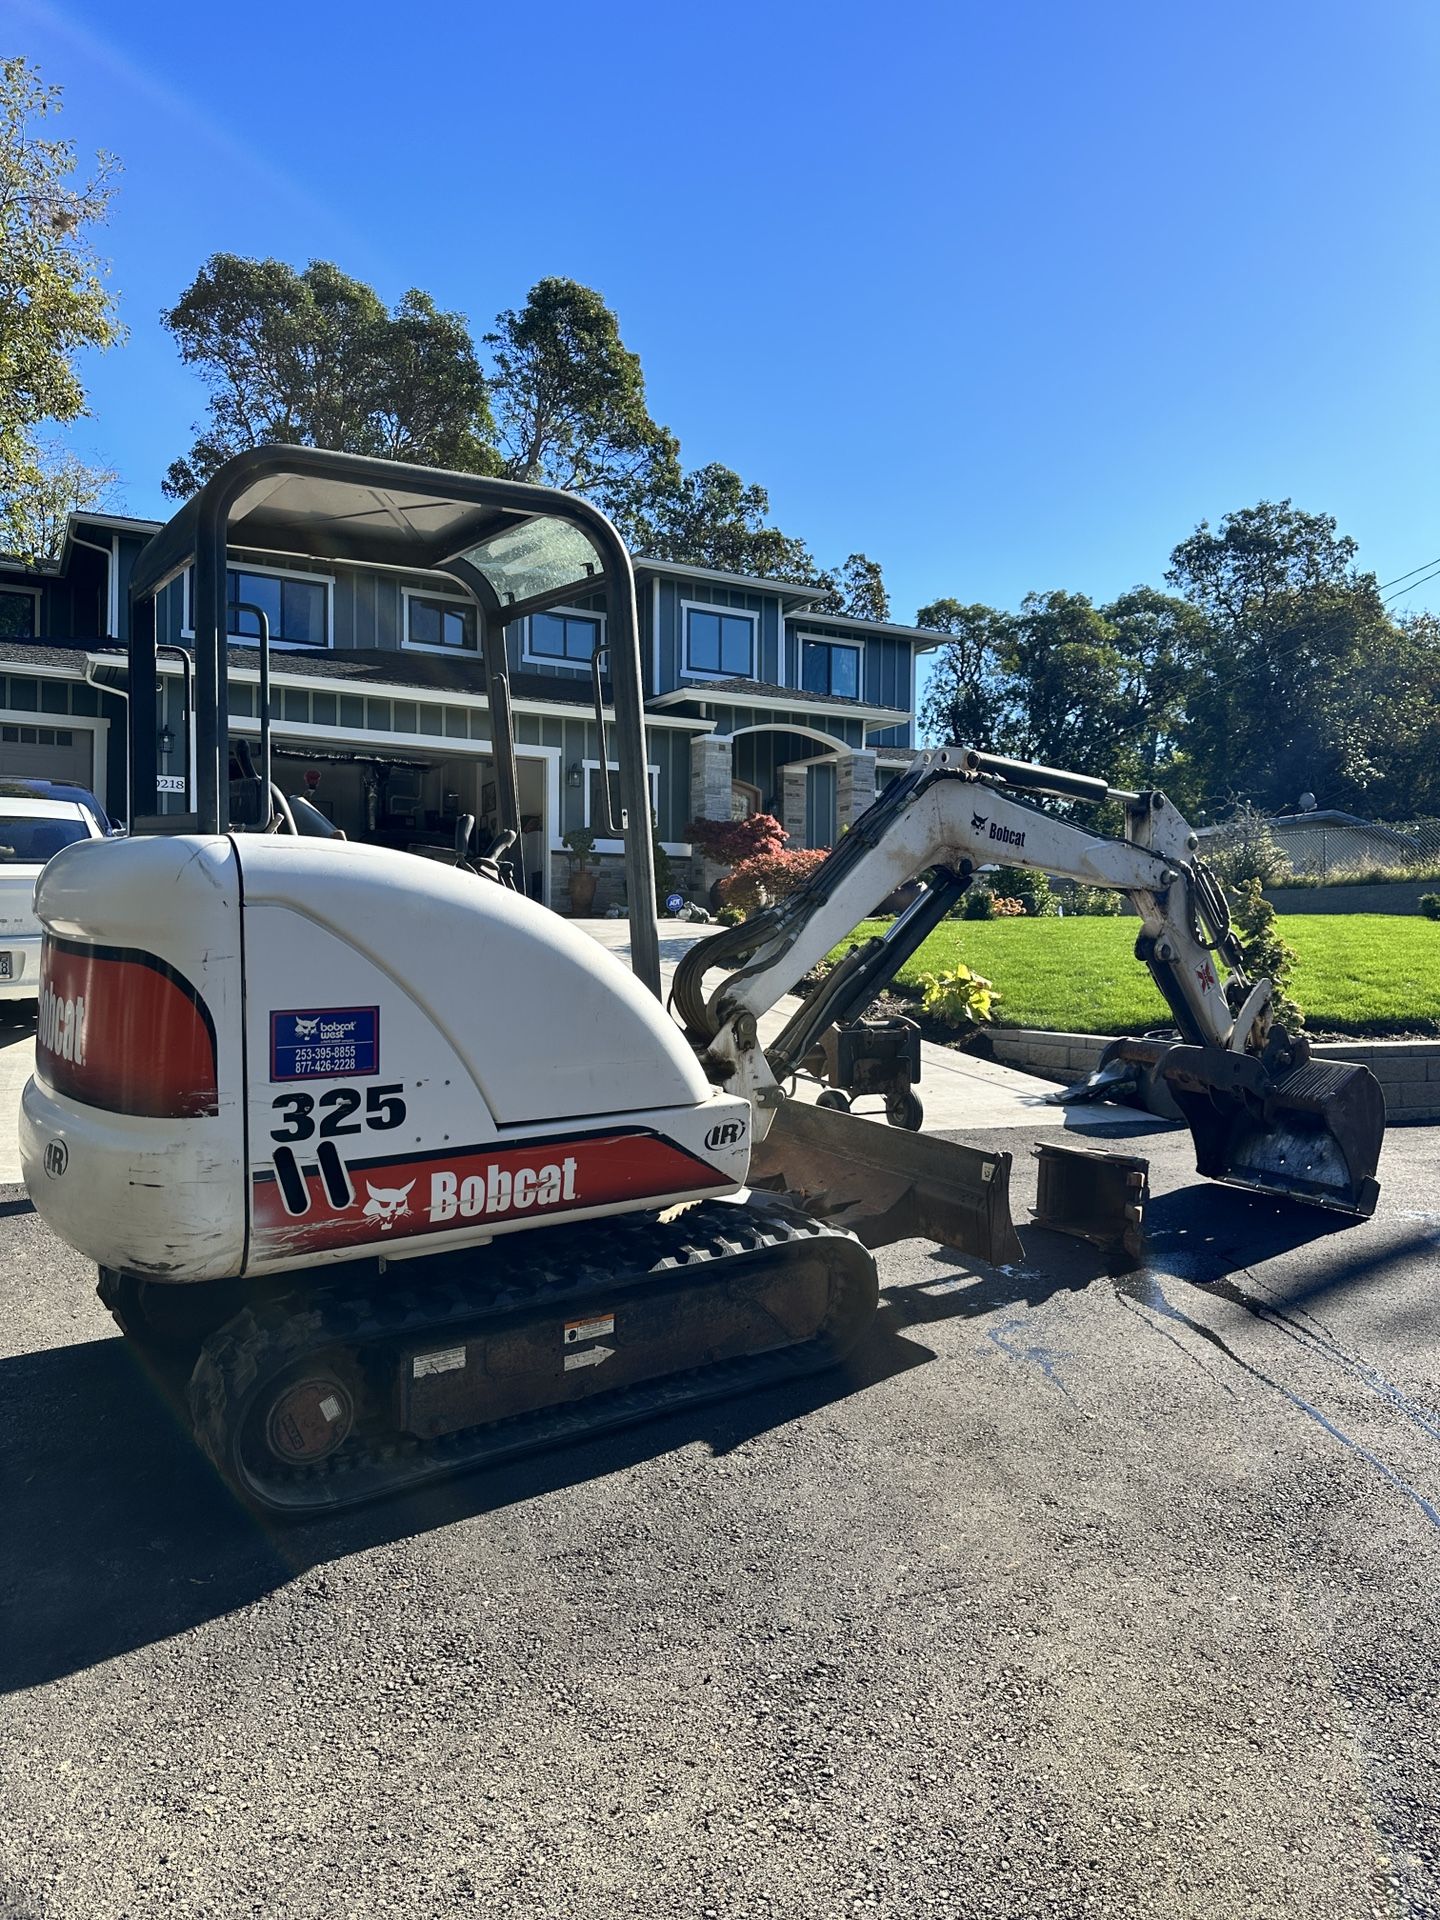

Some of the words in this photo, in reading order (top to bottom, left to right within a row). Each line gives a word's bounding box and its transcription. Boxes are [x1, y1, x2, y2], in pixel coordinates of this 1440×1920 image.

[989, 822, 1026, 847] Bobcat
[320, 1022, 355, 1032] bobcat
[320, 1031, 344, 1039] west
[295, 1046, 356, 1060] 253-395-8855
[295, 1059, 356, 1073] 877-426-2228
[270, 1083, 407, 1143] 325
[711, 1124, 739, 1145] IR
[46, 1143, 64, 1176] IR
[429, 1157, 577, 1222] Bobcat
